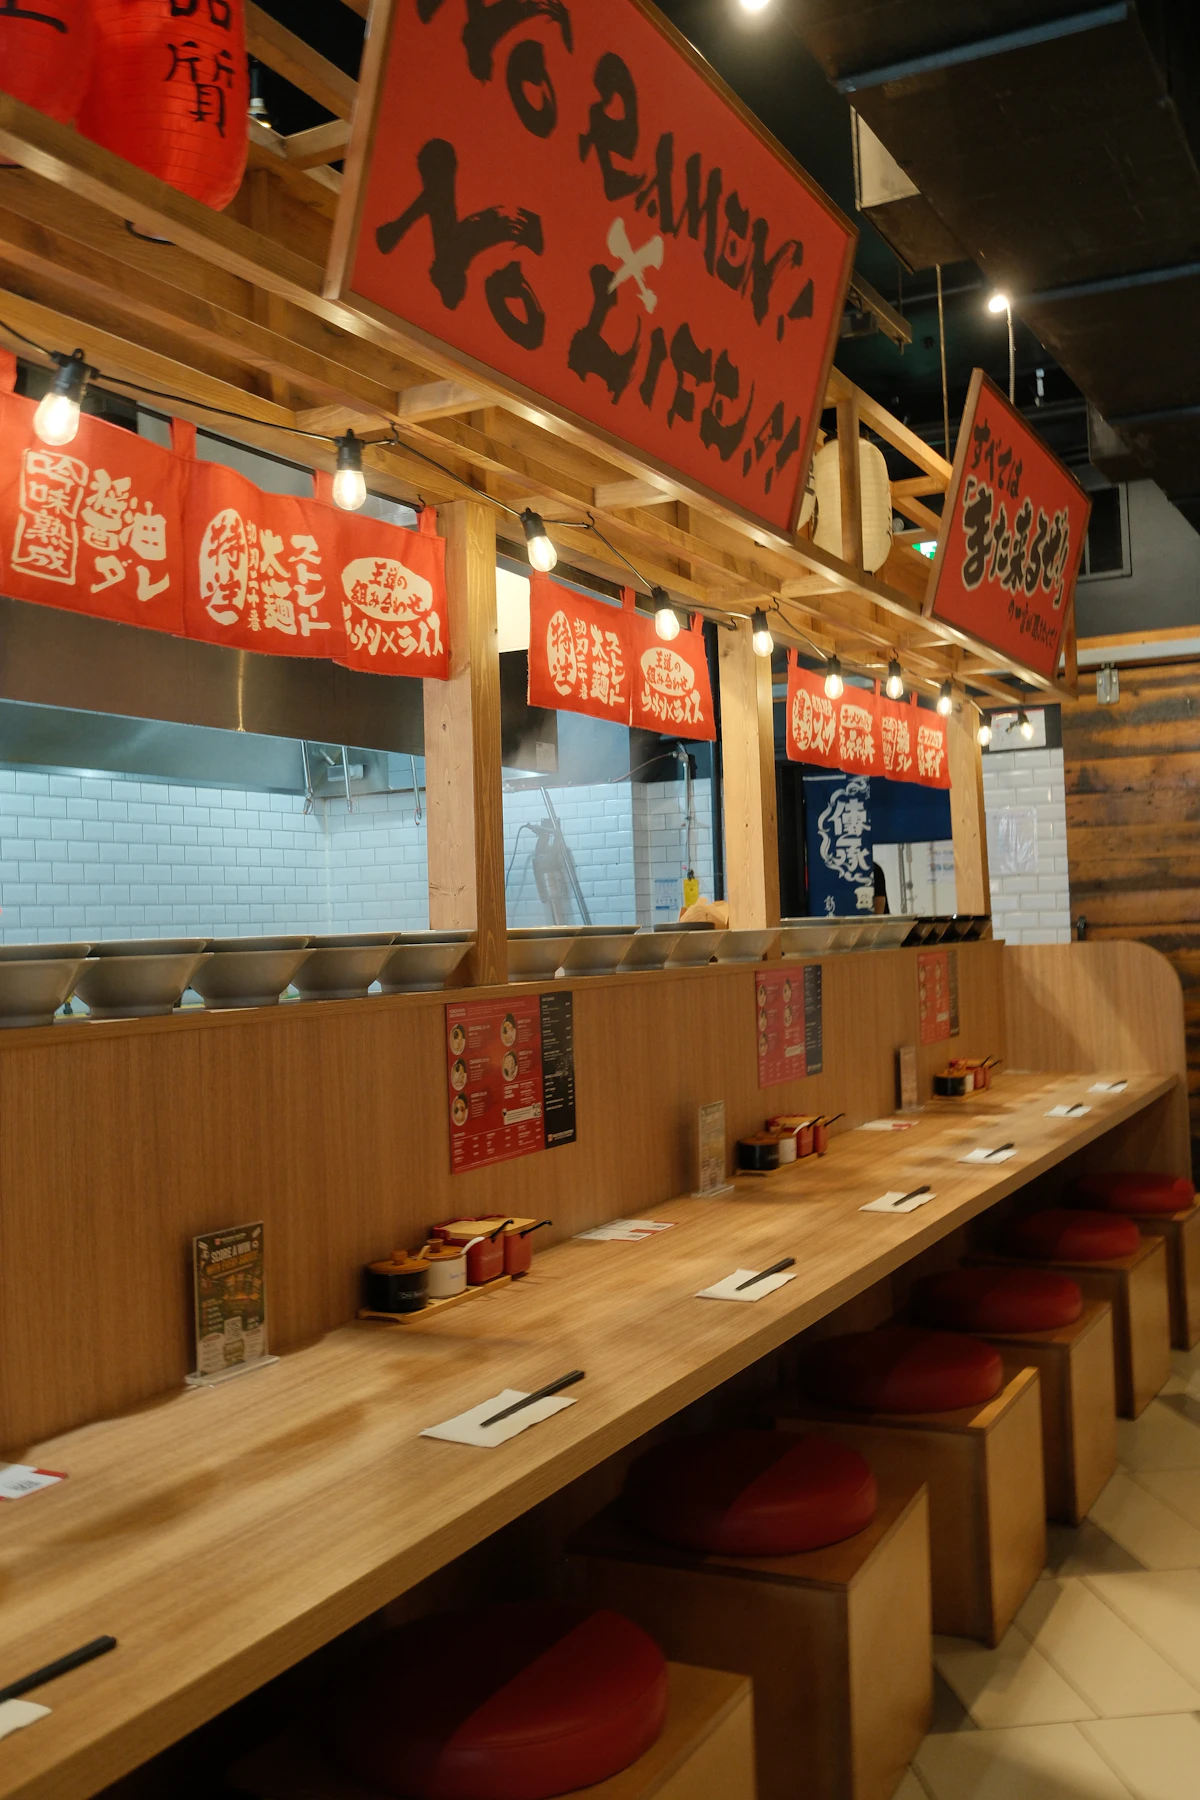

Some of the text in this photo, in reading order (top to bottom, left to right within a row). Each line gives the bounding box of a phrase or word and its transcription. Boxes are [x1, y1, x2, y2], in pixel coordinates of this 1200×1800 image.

[376, 138, 545, 350] NO
[24, 451, 75, 575] 吟味熟成
[259, 528, 298, 636] 太麺
[288, 534, 332, 637] ストレート
[350, 579, 429, 616] 組み合わせ
[605, 631, 626, 706] ストレート
[646, 667, 693, 693] 組み合わせ
[210, 1246, 232, 1264] SCORE
